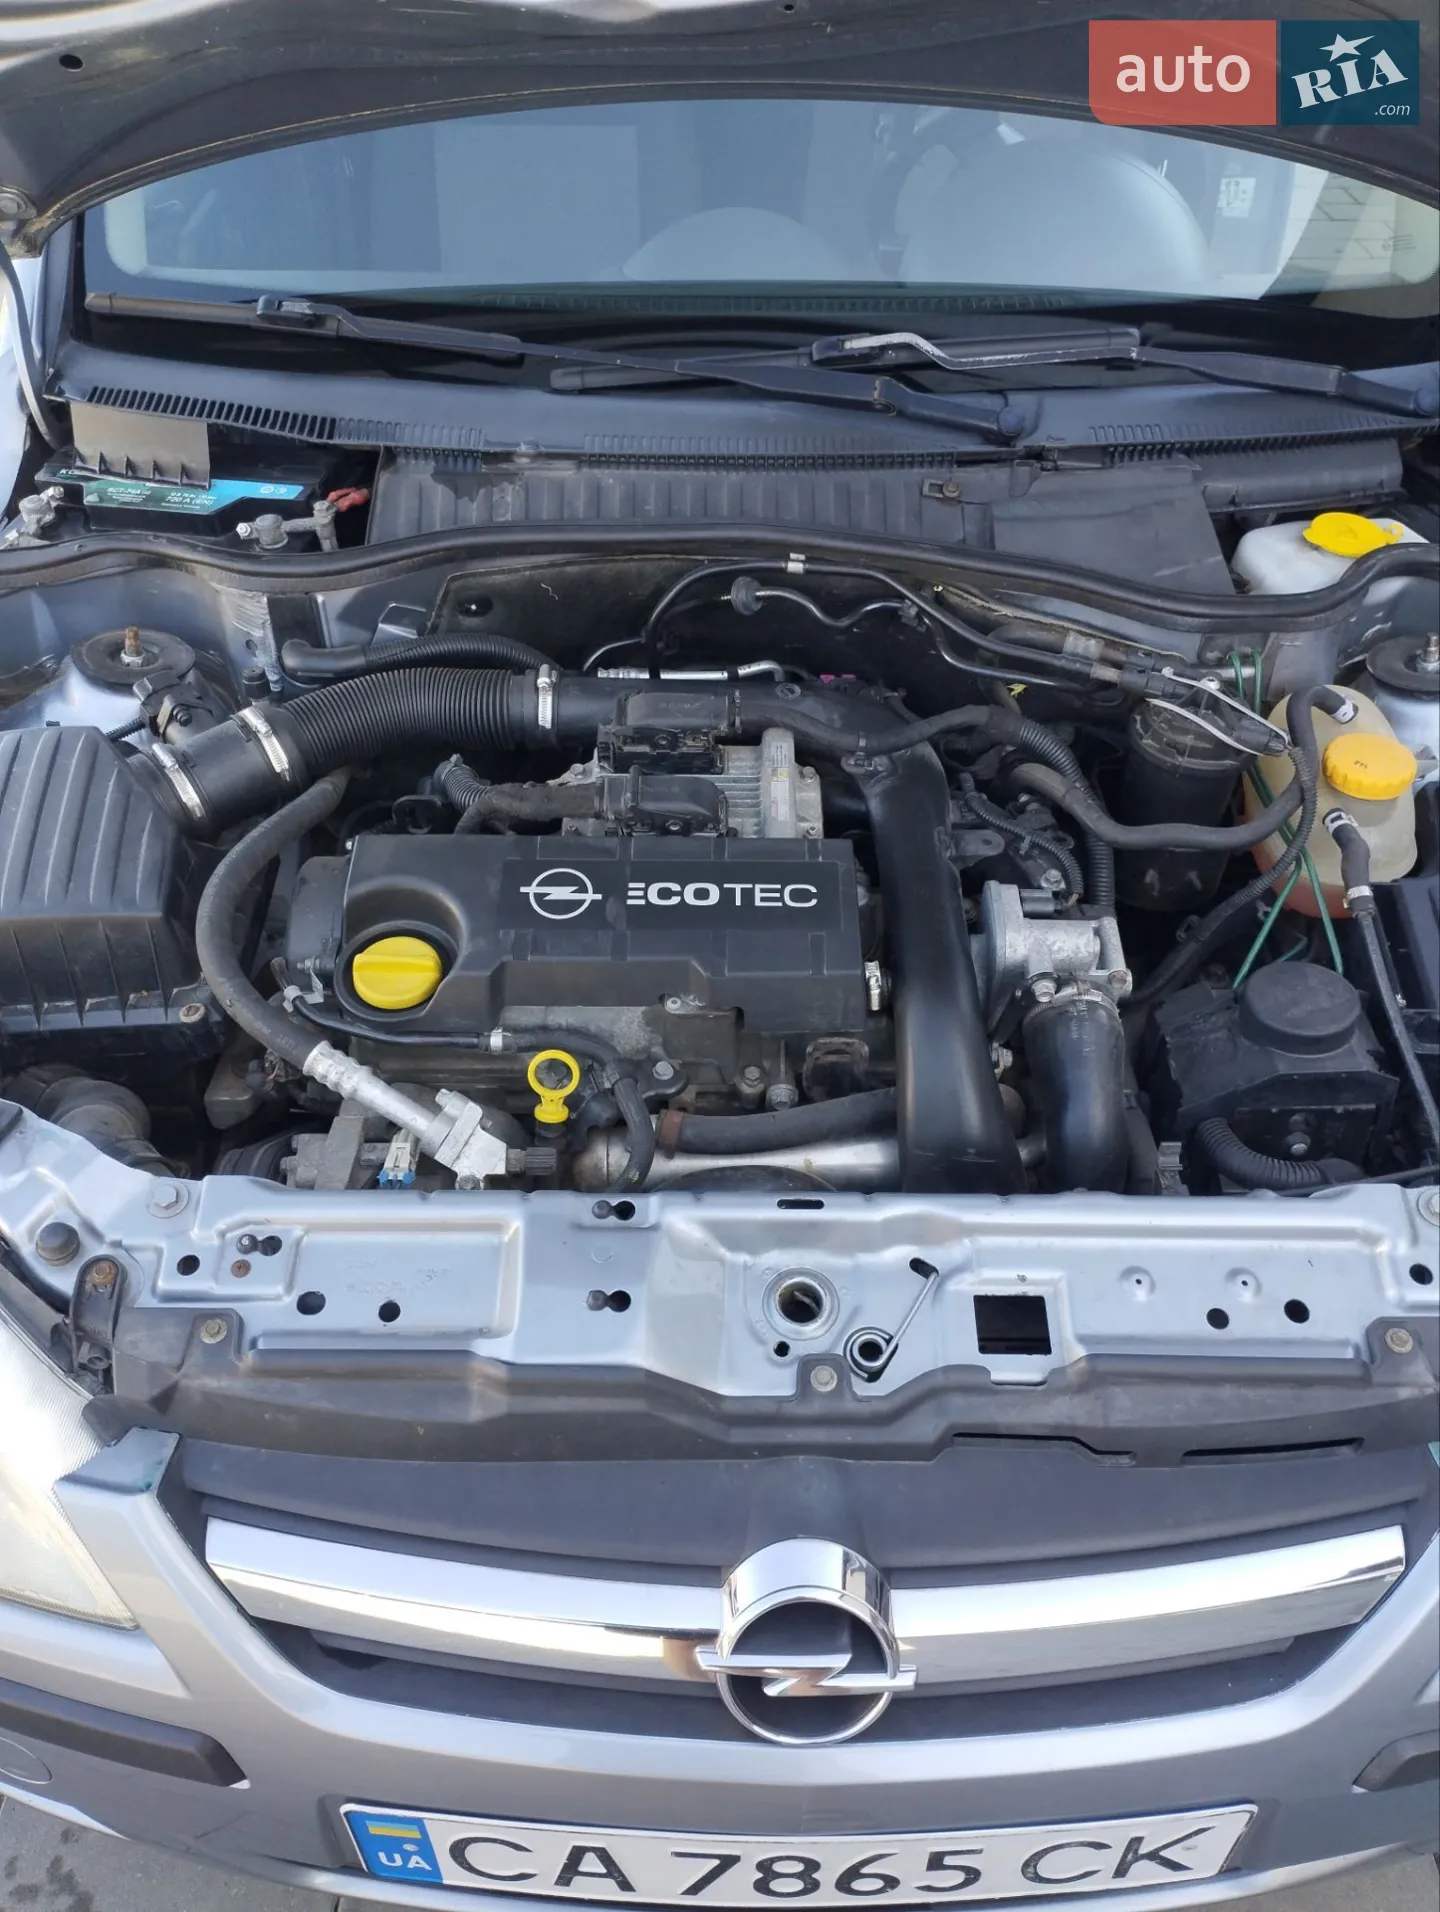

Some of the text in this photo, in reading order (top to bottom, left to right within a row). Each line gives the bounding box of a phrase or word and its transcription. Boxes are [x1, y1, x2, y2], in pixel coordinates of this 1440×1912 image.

[627, 882, 818, 908] ECOTEC
[378, 1851, 432, 1871] UA
[449, 1826, 1216, 1899] CA 7865 CK
